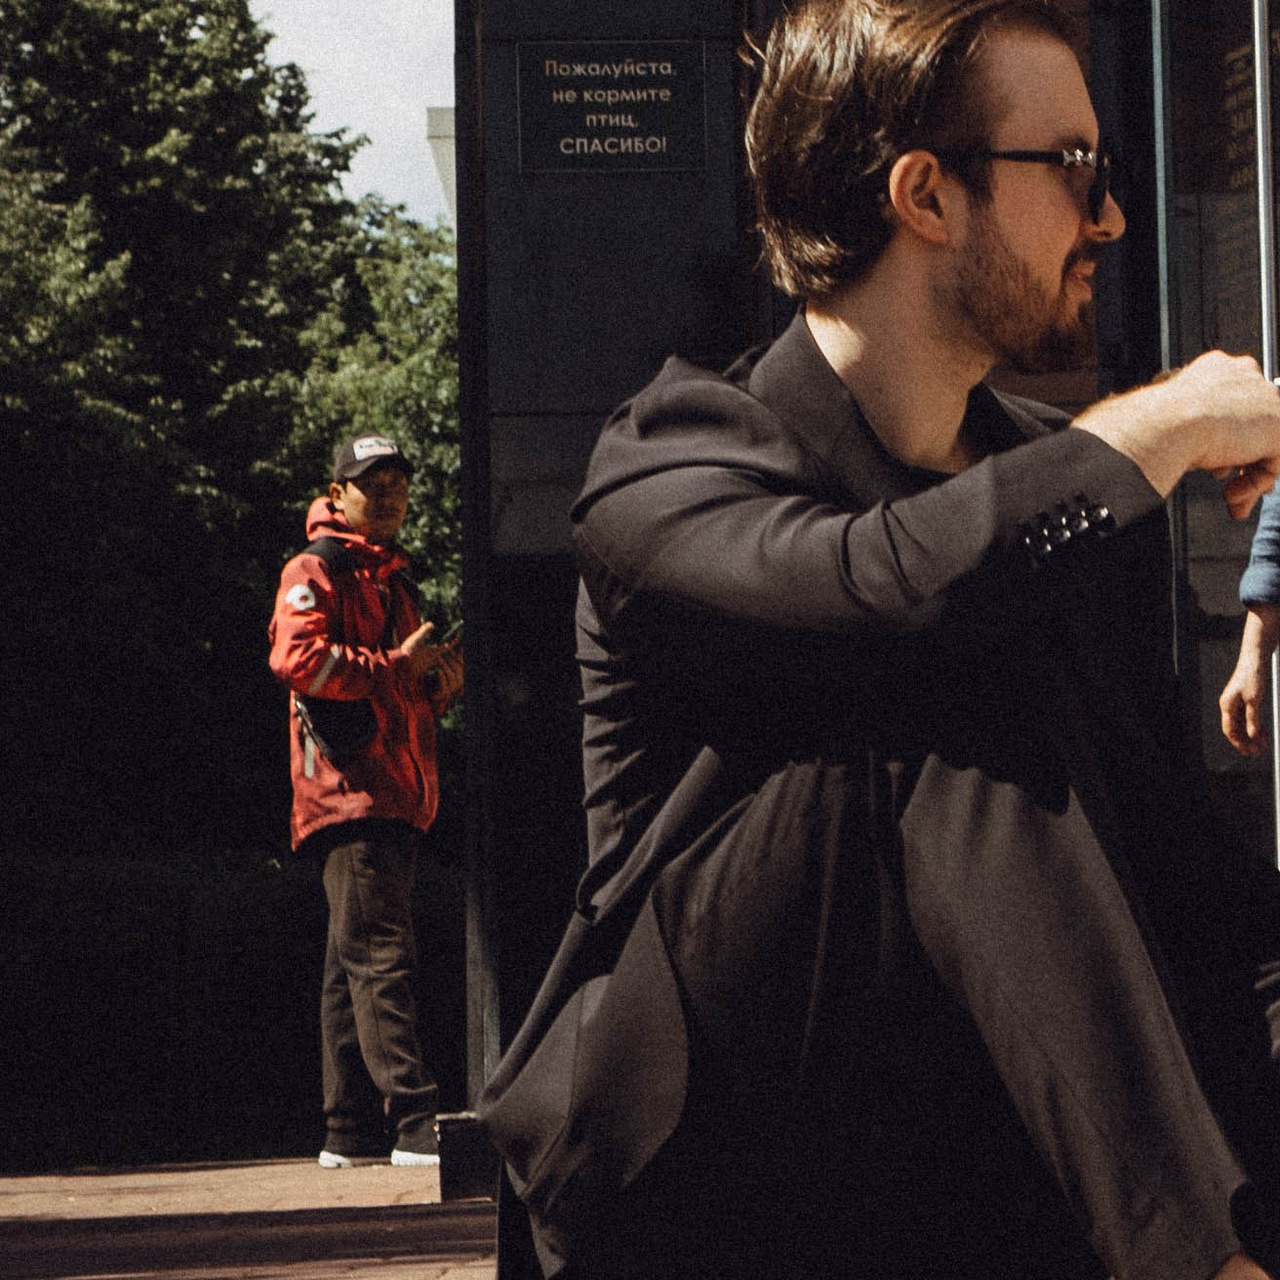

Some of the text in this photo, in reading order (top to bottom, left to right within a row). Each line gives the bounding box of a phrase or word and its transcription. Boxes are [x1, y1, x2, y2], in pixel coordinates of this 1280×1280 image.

[553, 88, 671, 108] не кормите
[560, 136, 668, 155] СПАСИБО!
